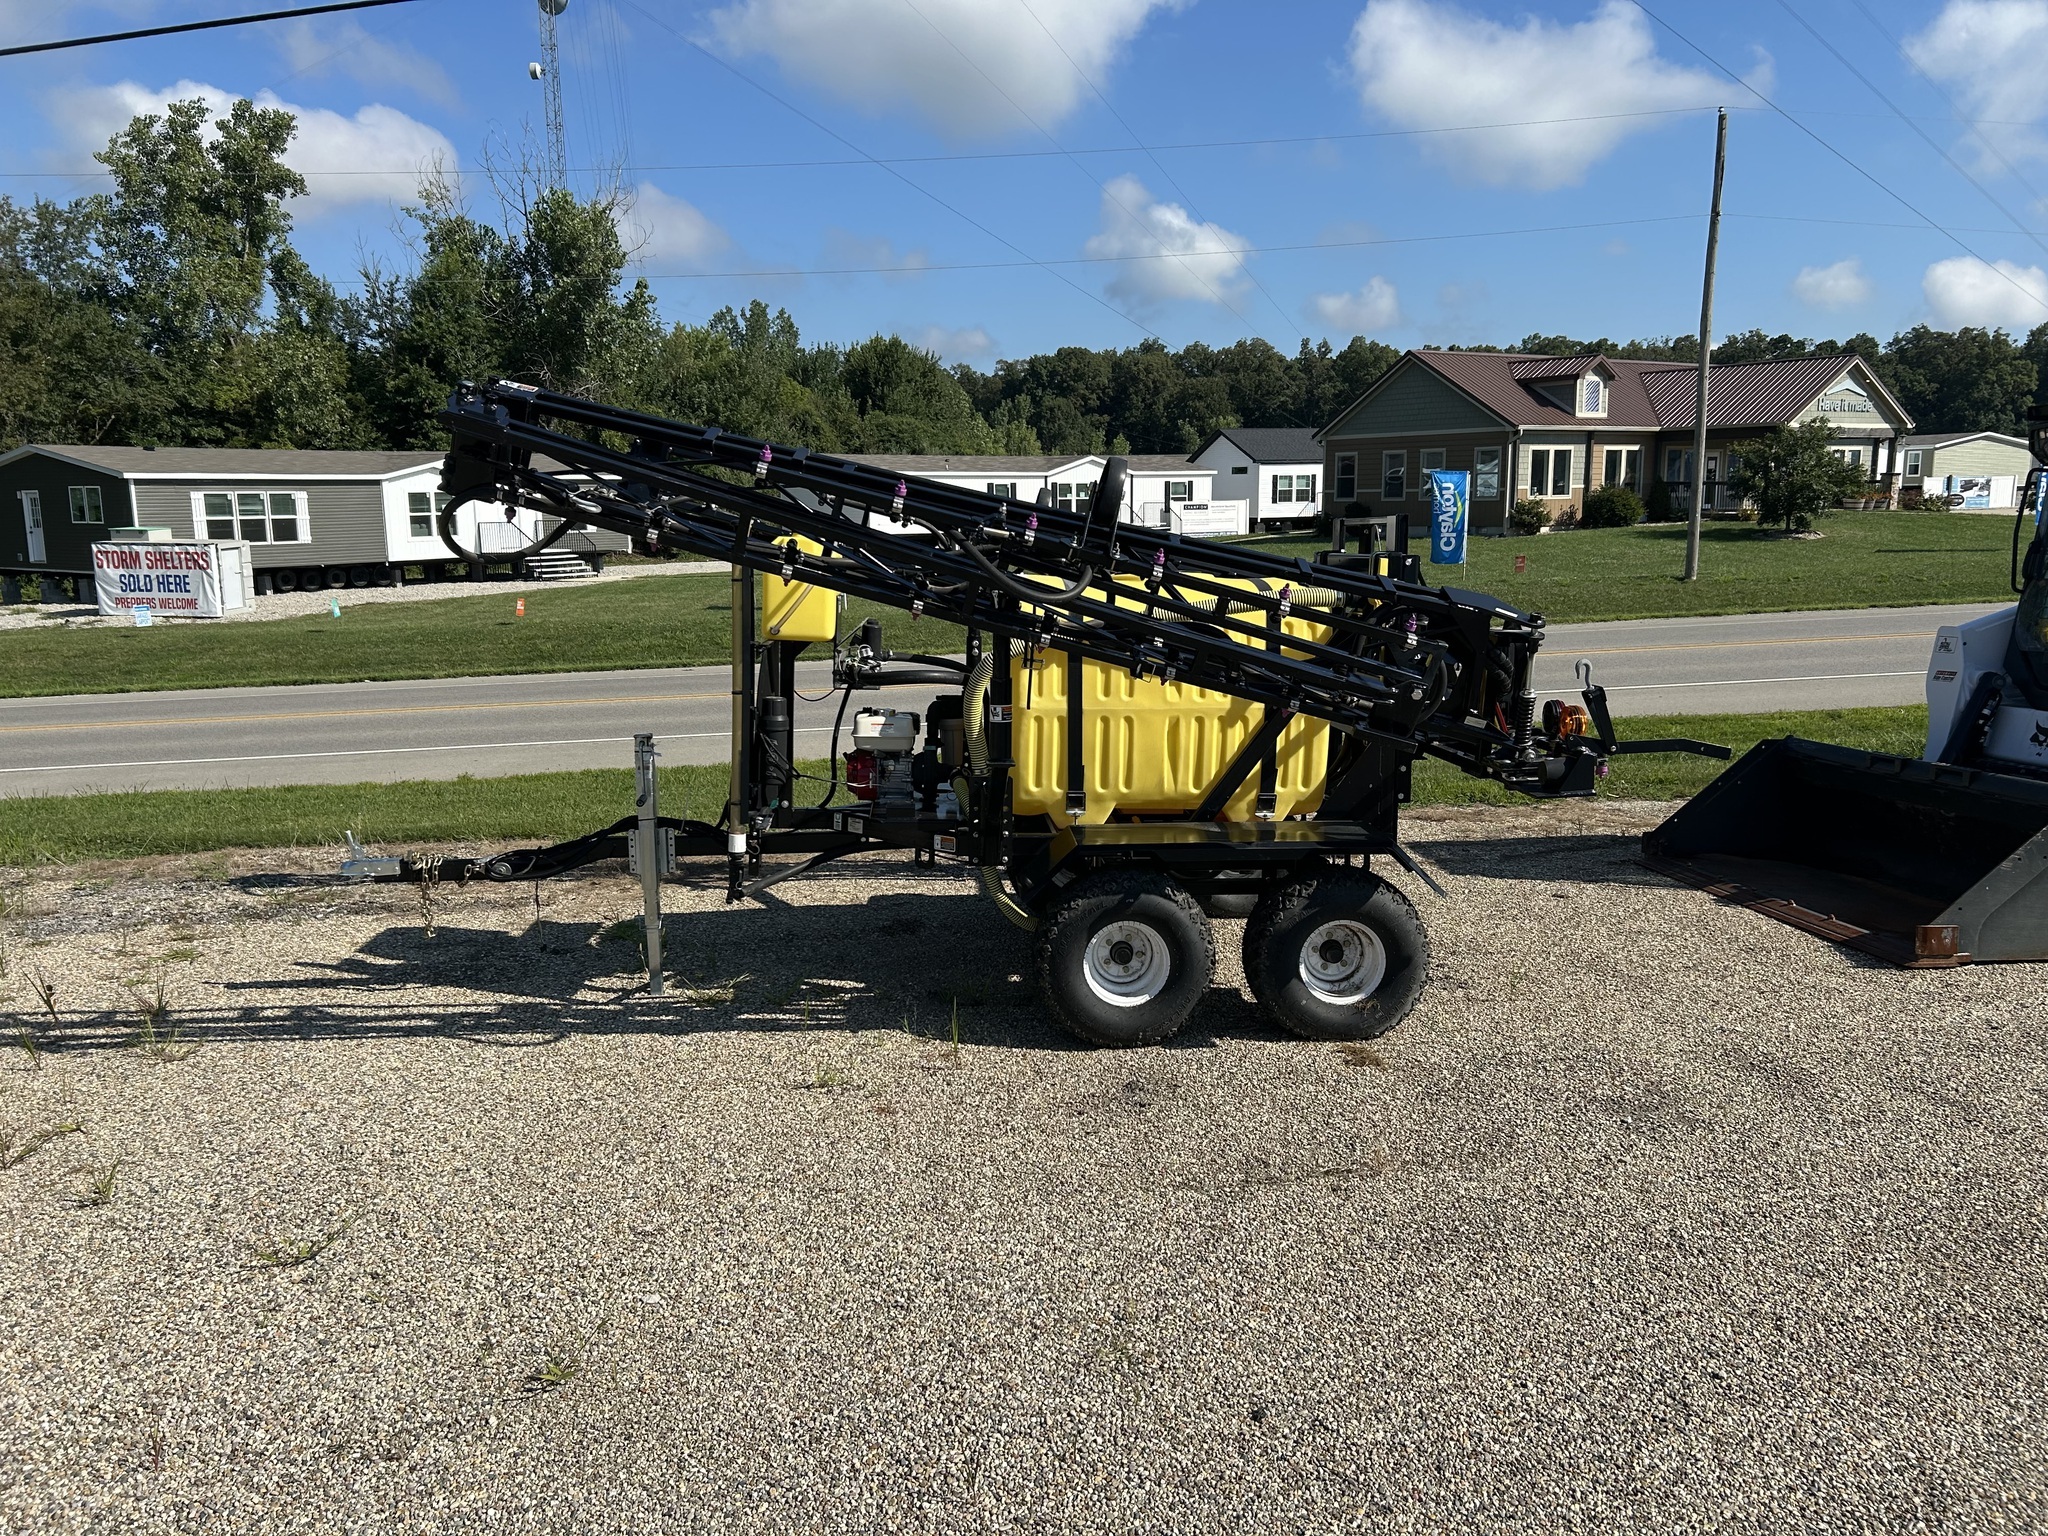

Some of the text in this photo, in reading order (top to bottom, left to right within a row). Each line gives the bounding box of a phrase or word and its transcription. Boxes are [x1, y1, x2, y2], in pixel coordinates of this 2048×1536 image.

[1818, 397, 1841, 411] Have
[1848, 399, 1873, 412] made
[95, 550, 210, 570] STORM SHELTERS
[119, 573, 191, 593] SOLD HERE
[158, 598, 199, 610] WELCOME
